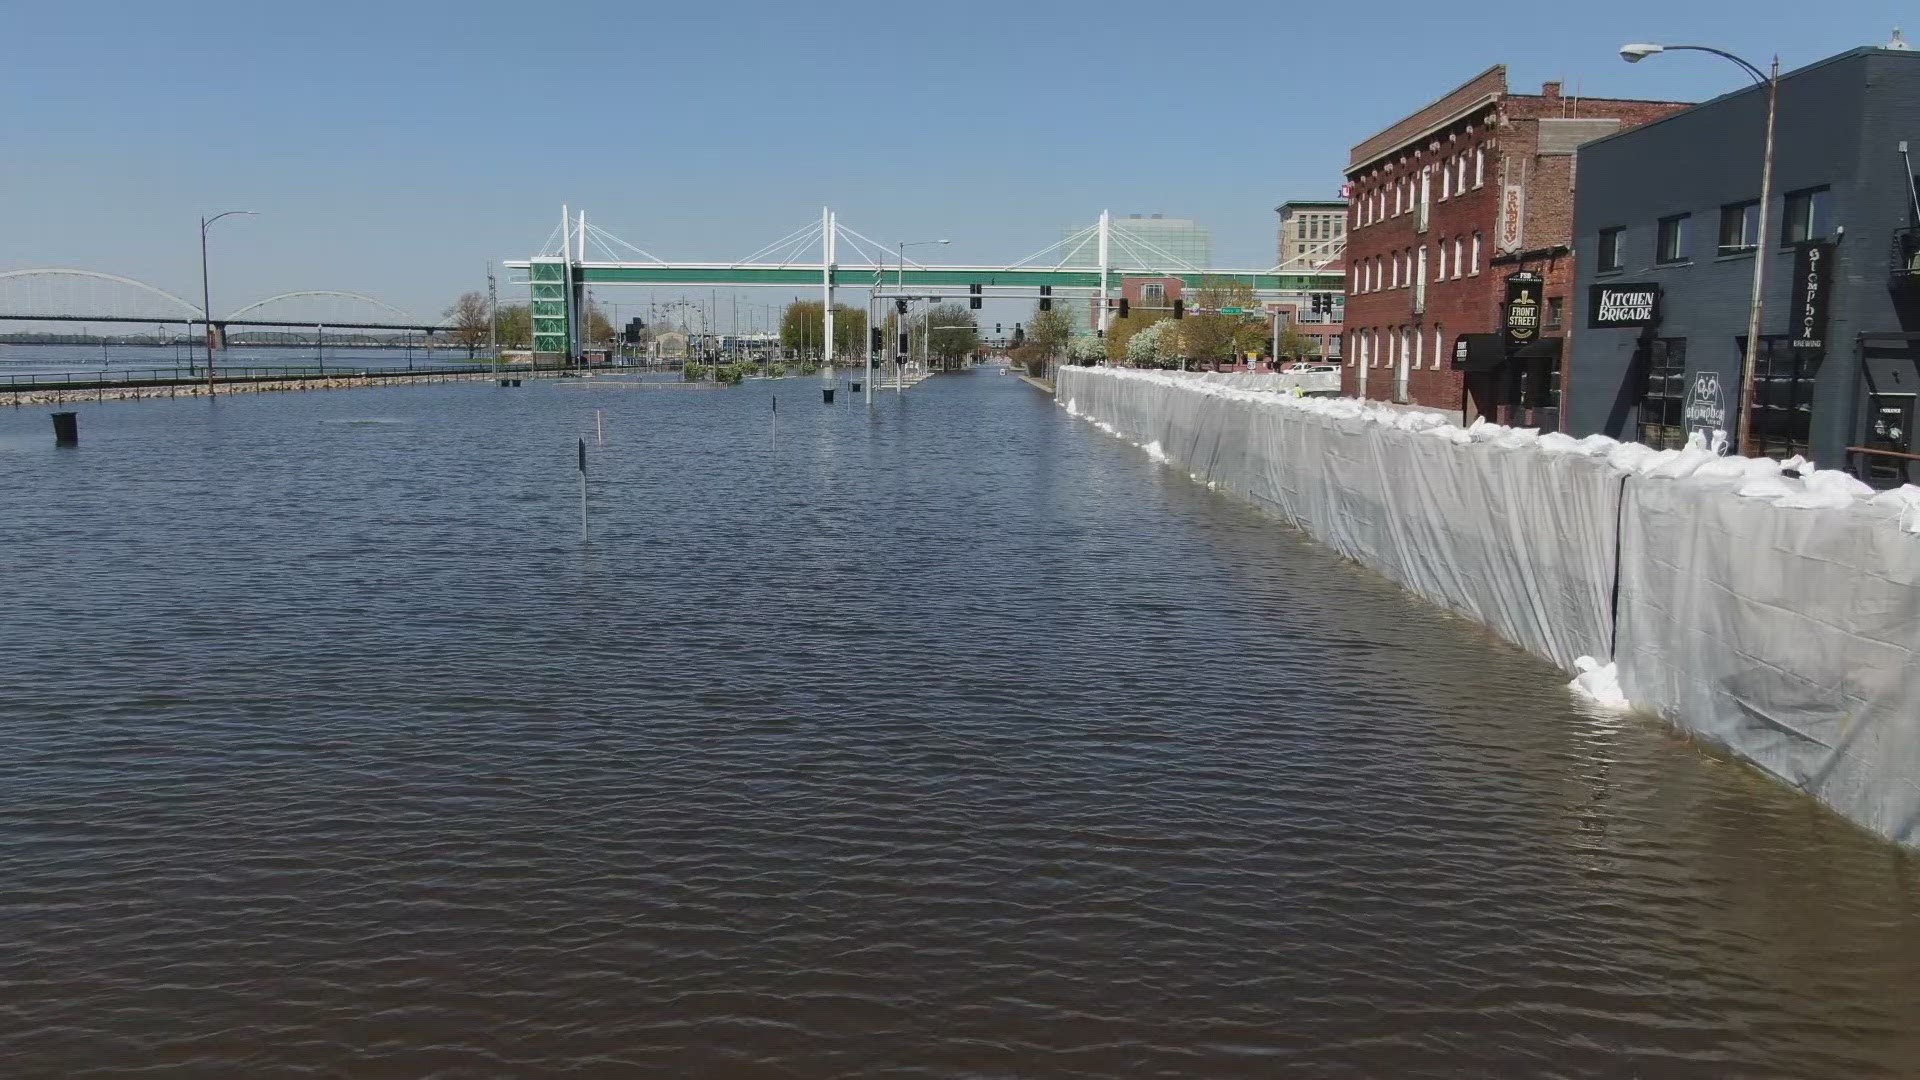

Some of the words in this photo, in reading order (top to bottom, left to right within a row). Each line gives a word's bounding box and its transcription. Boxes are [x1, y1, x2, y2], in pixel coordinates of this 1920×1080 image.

[1601, 290, 1654, 307] KITCHEN
[1512, 307, 1535, 316] FRONT
[1598, 305, 1651, 321] BRIGADE
[1509, 317, 1536, 326] STREET
